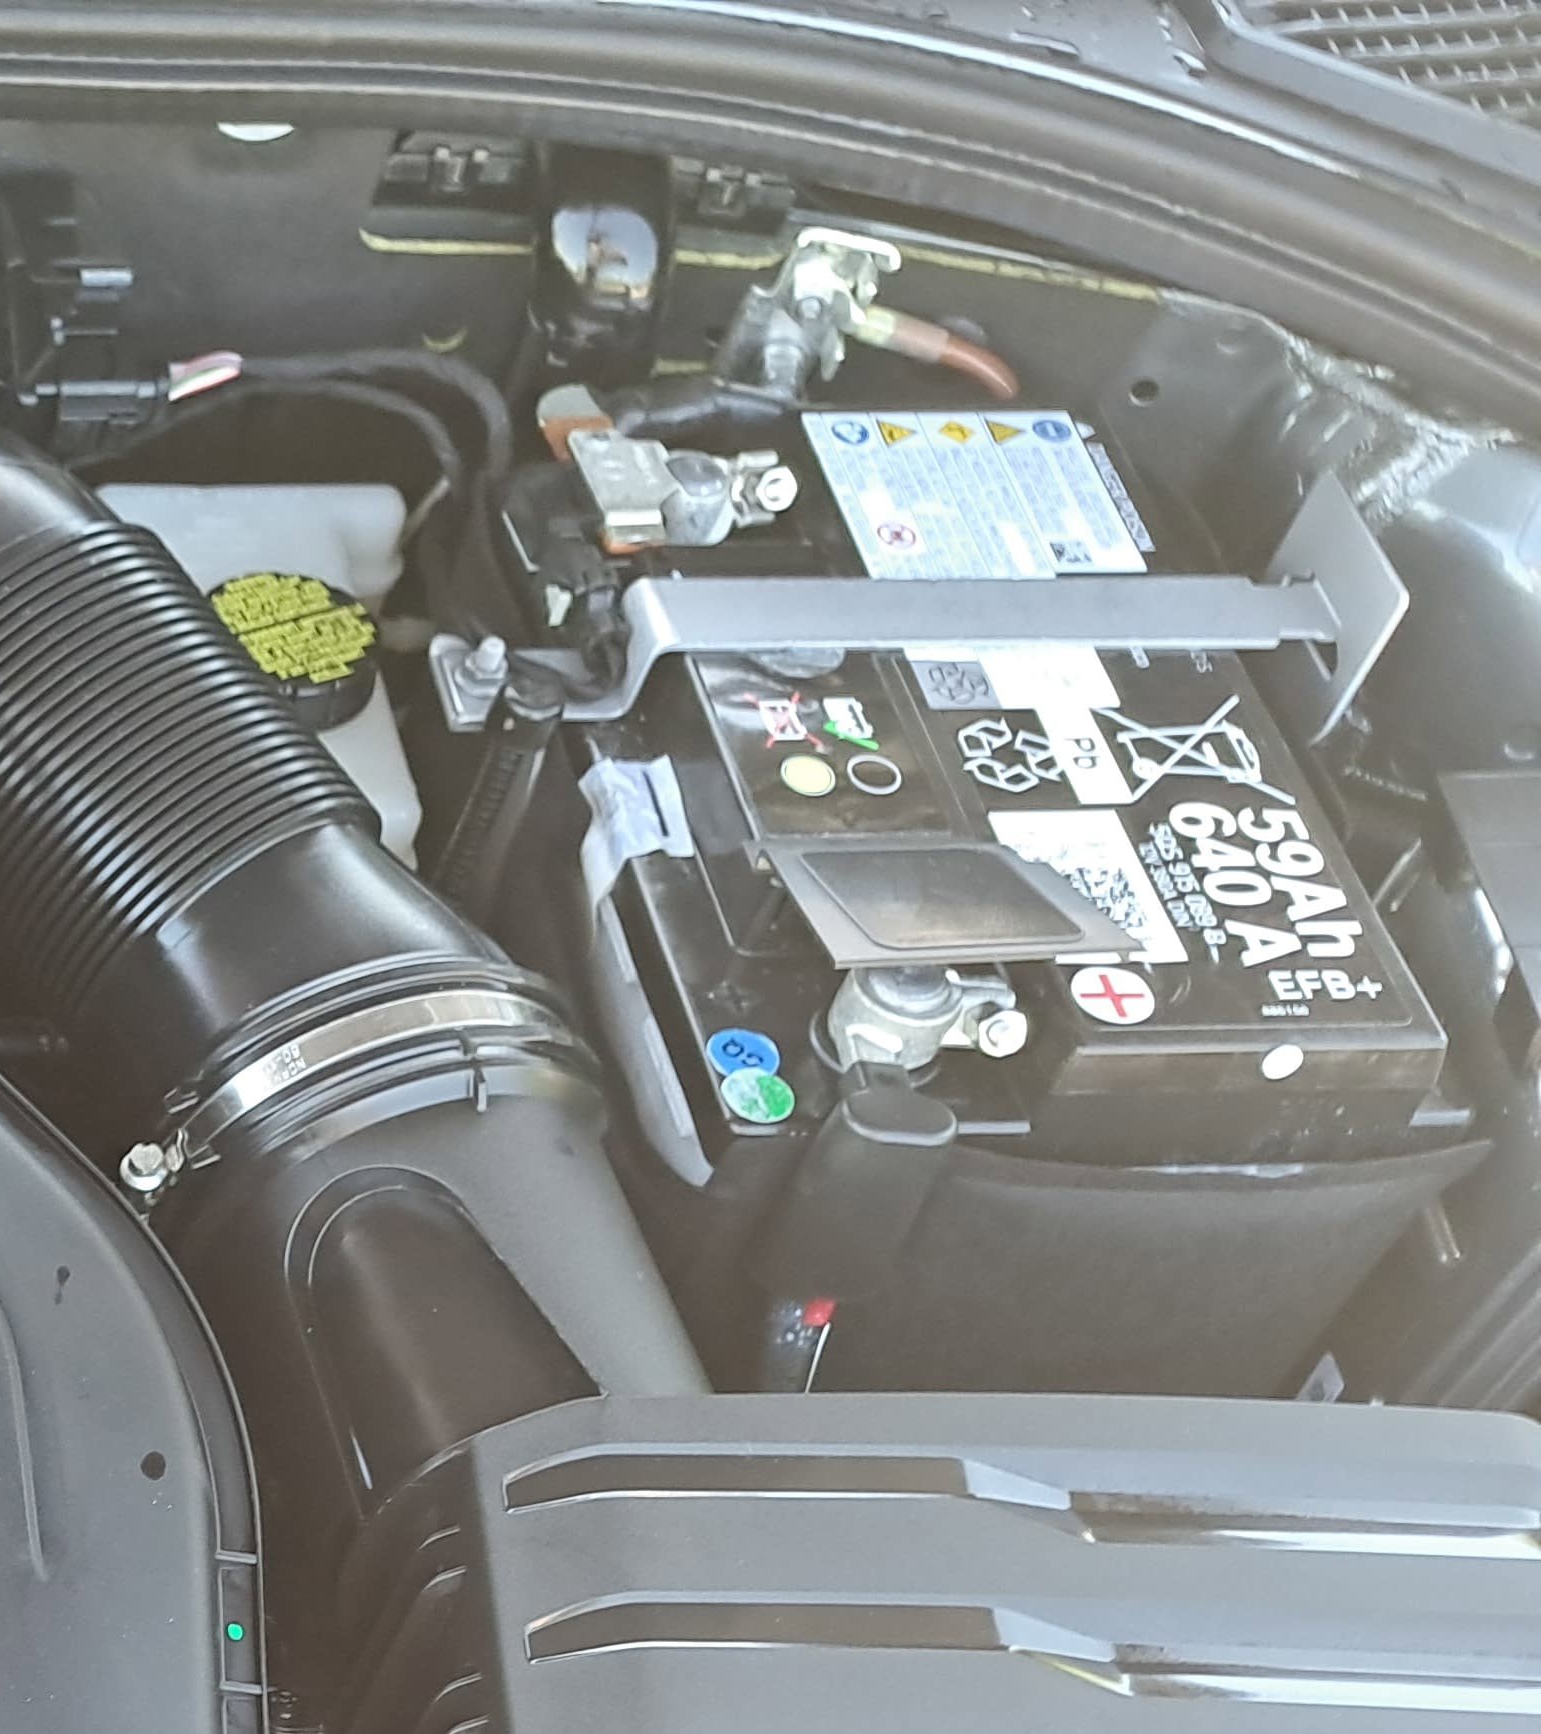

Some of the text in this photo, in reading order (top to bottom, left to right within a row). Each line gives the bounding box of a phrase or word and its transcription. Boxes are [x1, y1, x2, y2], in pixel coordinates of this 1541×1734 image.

[1066, 736, 1098, 769] Pb
[1168, 801, 1273, 907] 640
[1224, 919, 1302, 968] A
[1237, 806, 1363, 958] 59Ah
[1267, 968, 1383, 1001] EFB+
